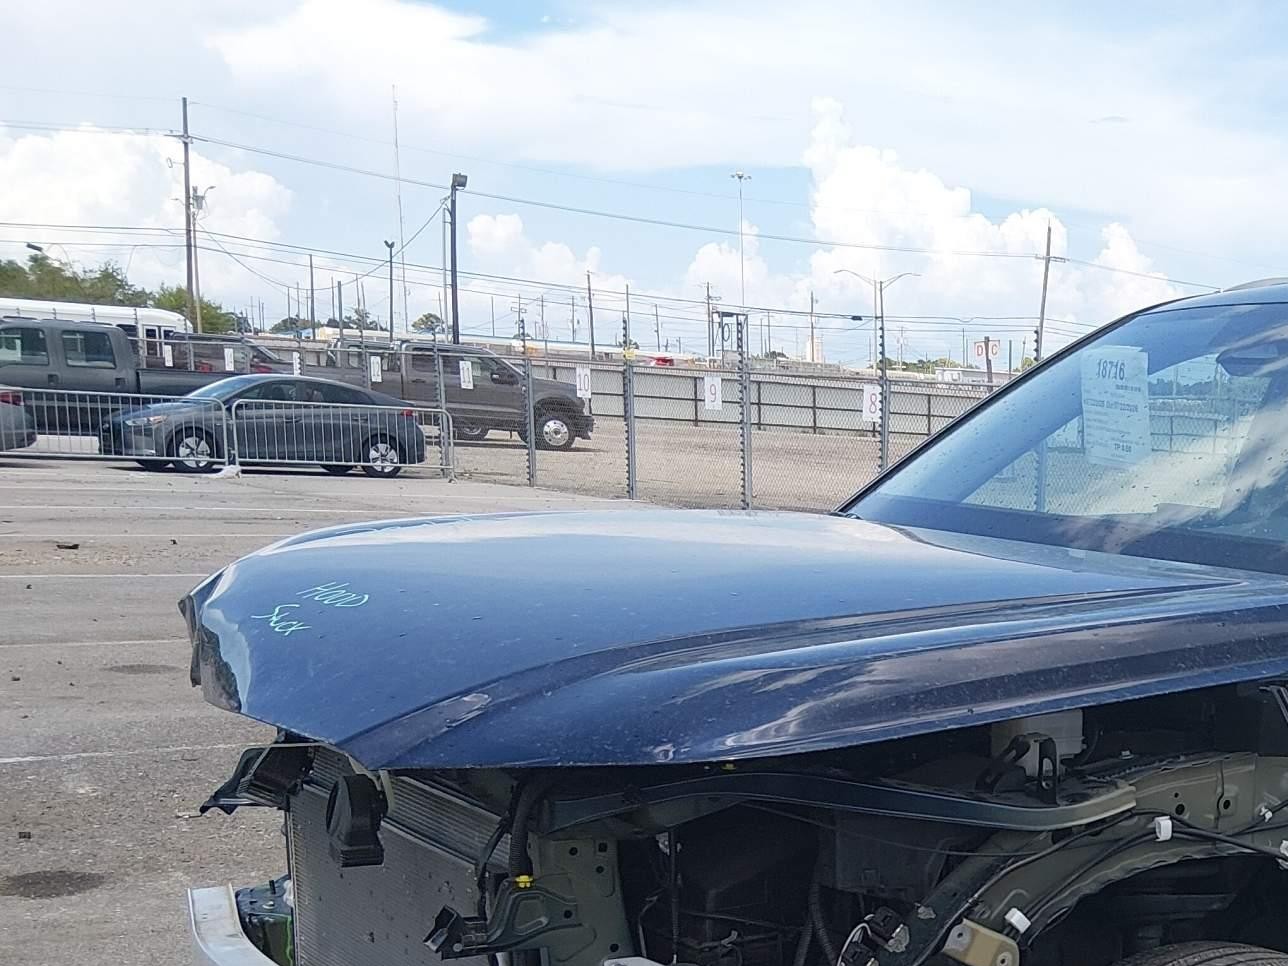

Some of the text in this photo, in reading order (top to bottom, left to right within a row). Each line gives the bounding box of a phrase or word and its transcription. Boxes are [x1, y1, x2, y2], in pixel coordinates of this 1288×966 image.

[1096, 359, 1126, 380] 18716
[577, 373, 590, 392] 10
[709, 383, 717, 402] 9
[868, 392, 877, 414] 8
[296, 581, 369, 607] HOOD
